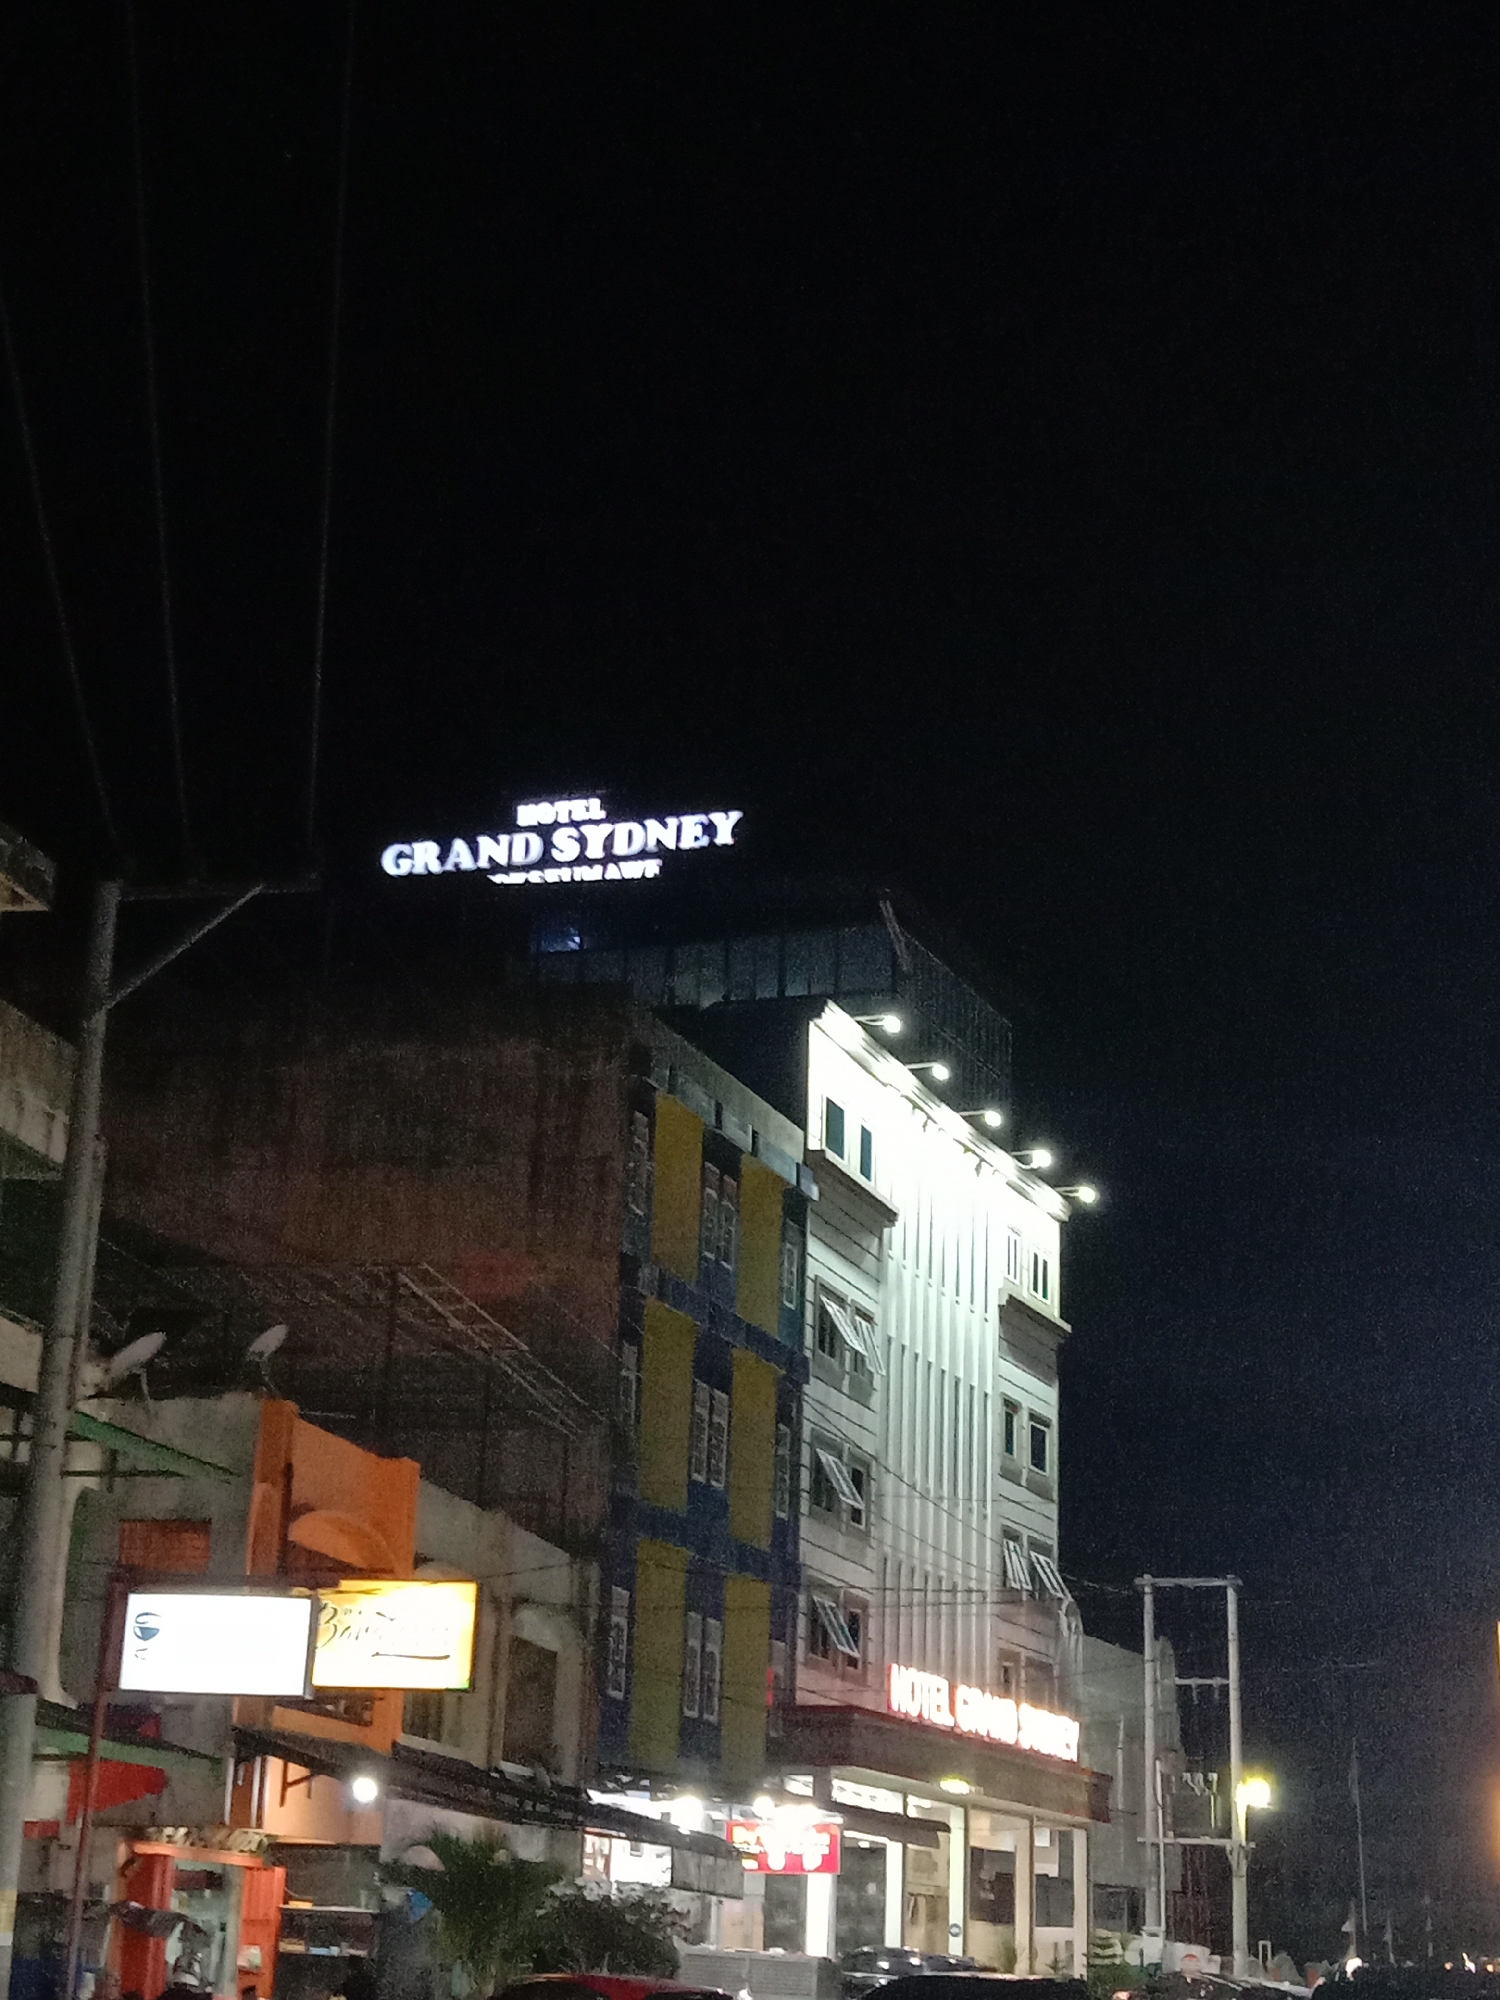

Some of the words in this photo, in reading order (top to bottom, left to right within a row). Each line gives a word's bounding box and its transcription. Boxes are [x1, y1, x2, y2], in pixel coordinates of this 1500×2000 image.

[381, 832, 543, 878] GRAND
[551, 810, 743, 863] SYDNEY
[516, 798, 606, 827] HOTEL
[890, 1663, 955, 1727] HOTEL
